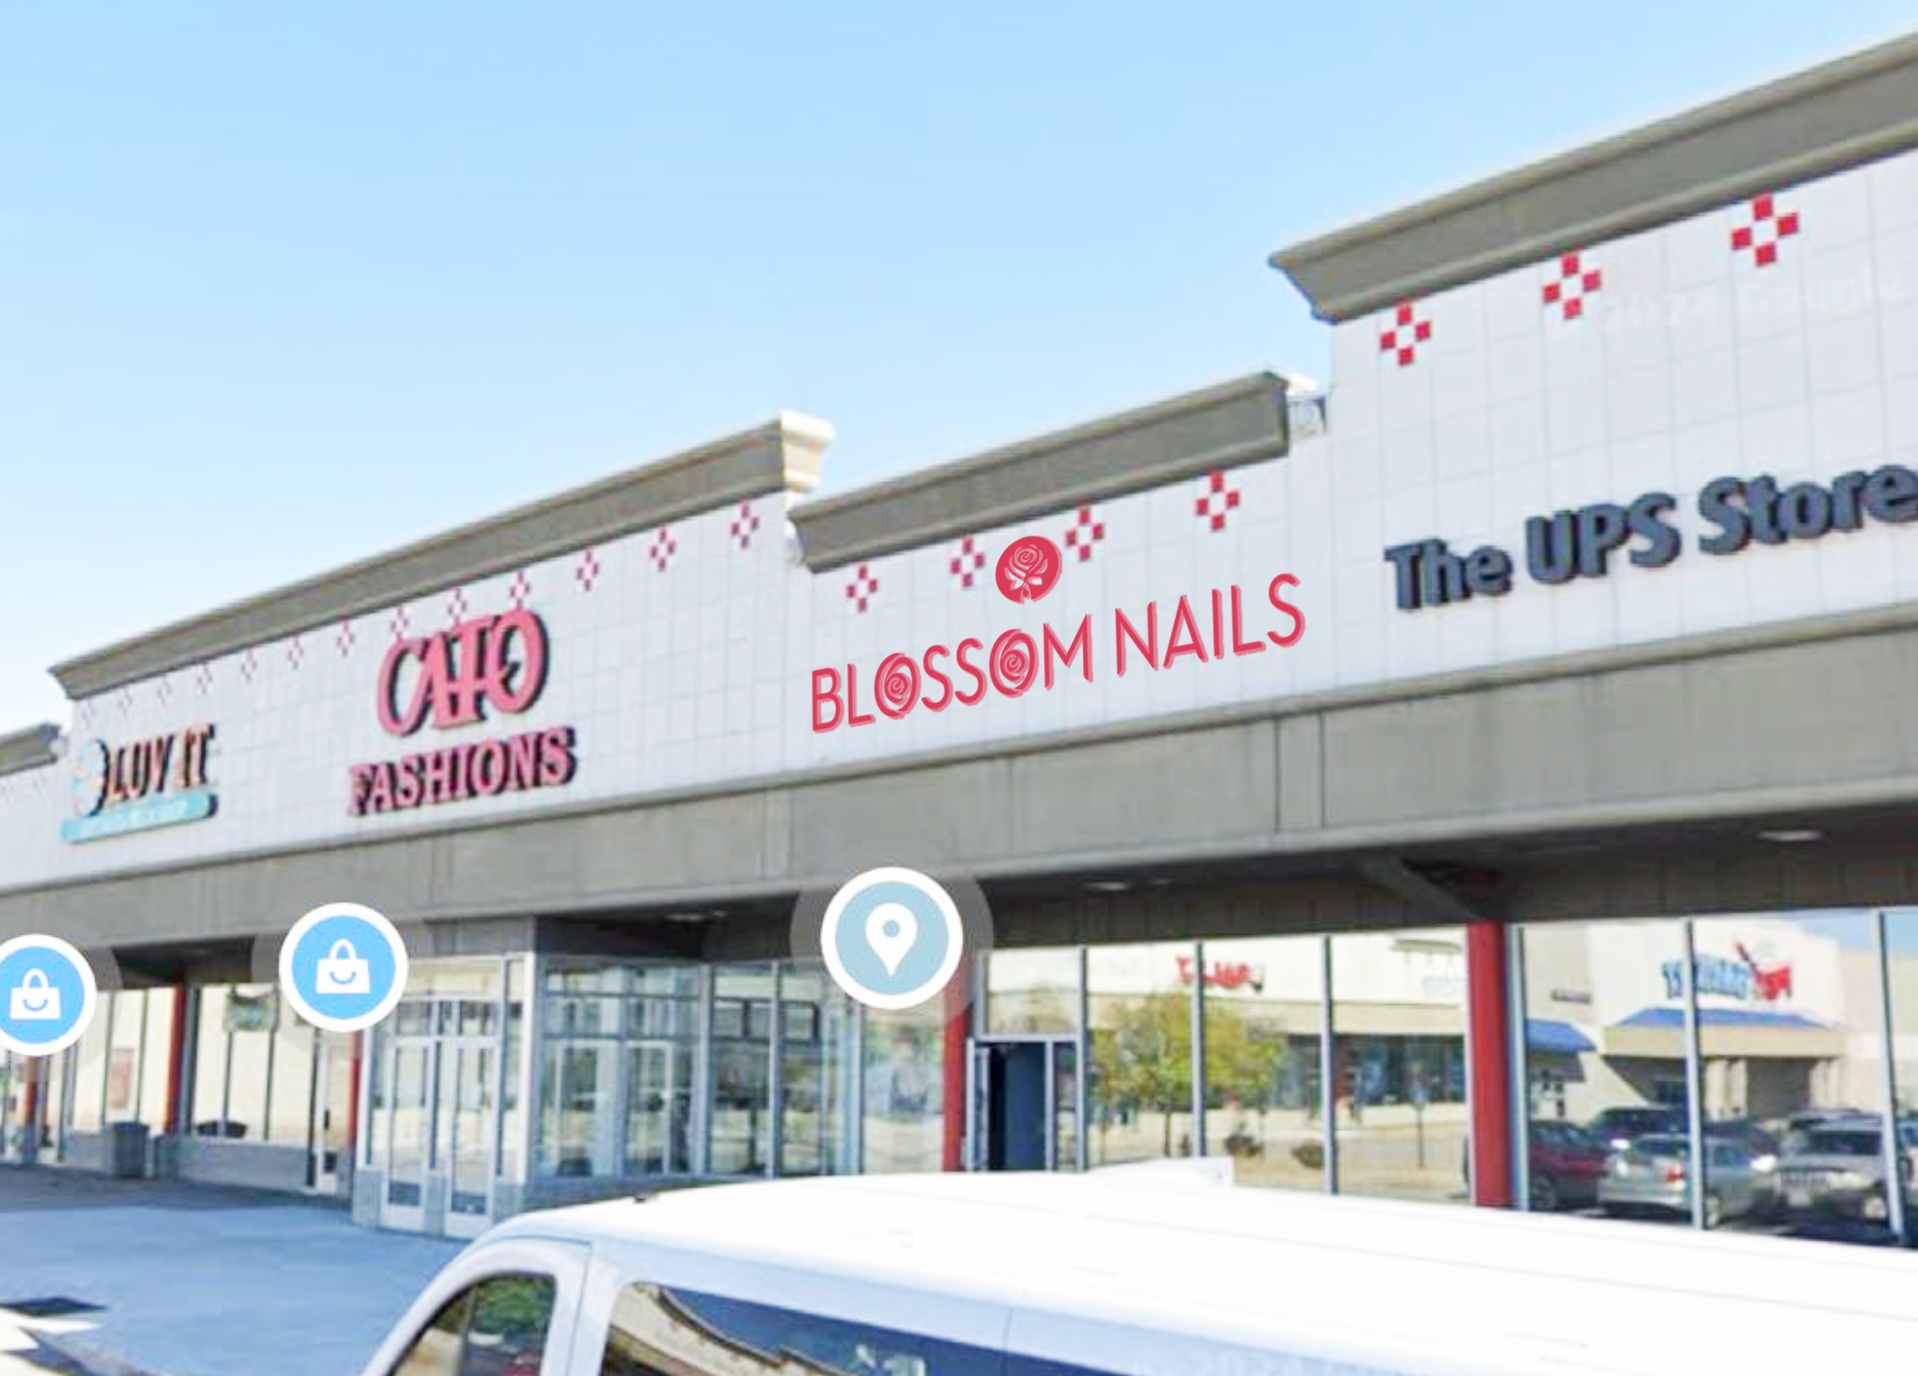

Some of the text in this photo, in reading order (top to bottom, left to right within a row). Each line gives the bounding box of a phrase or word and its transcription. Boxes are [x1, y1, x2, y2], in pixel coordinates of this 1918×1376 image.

[1385, 464, 1918, 610] The UPS Store
[377, 607, 550, 737] CATO
[811, 572, 1306, 734] BLOSSOM NAILS
[106, 721, 217, 802] LUV IT
[347, 726, 578, 816] FASHIONS
